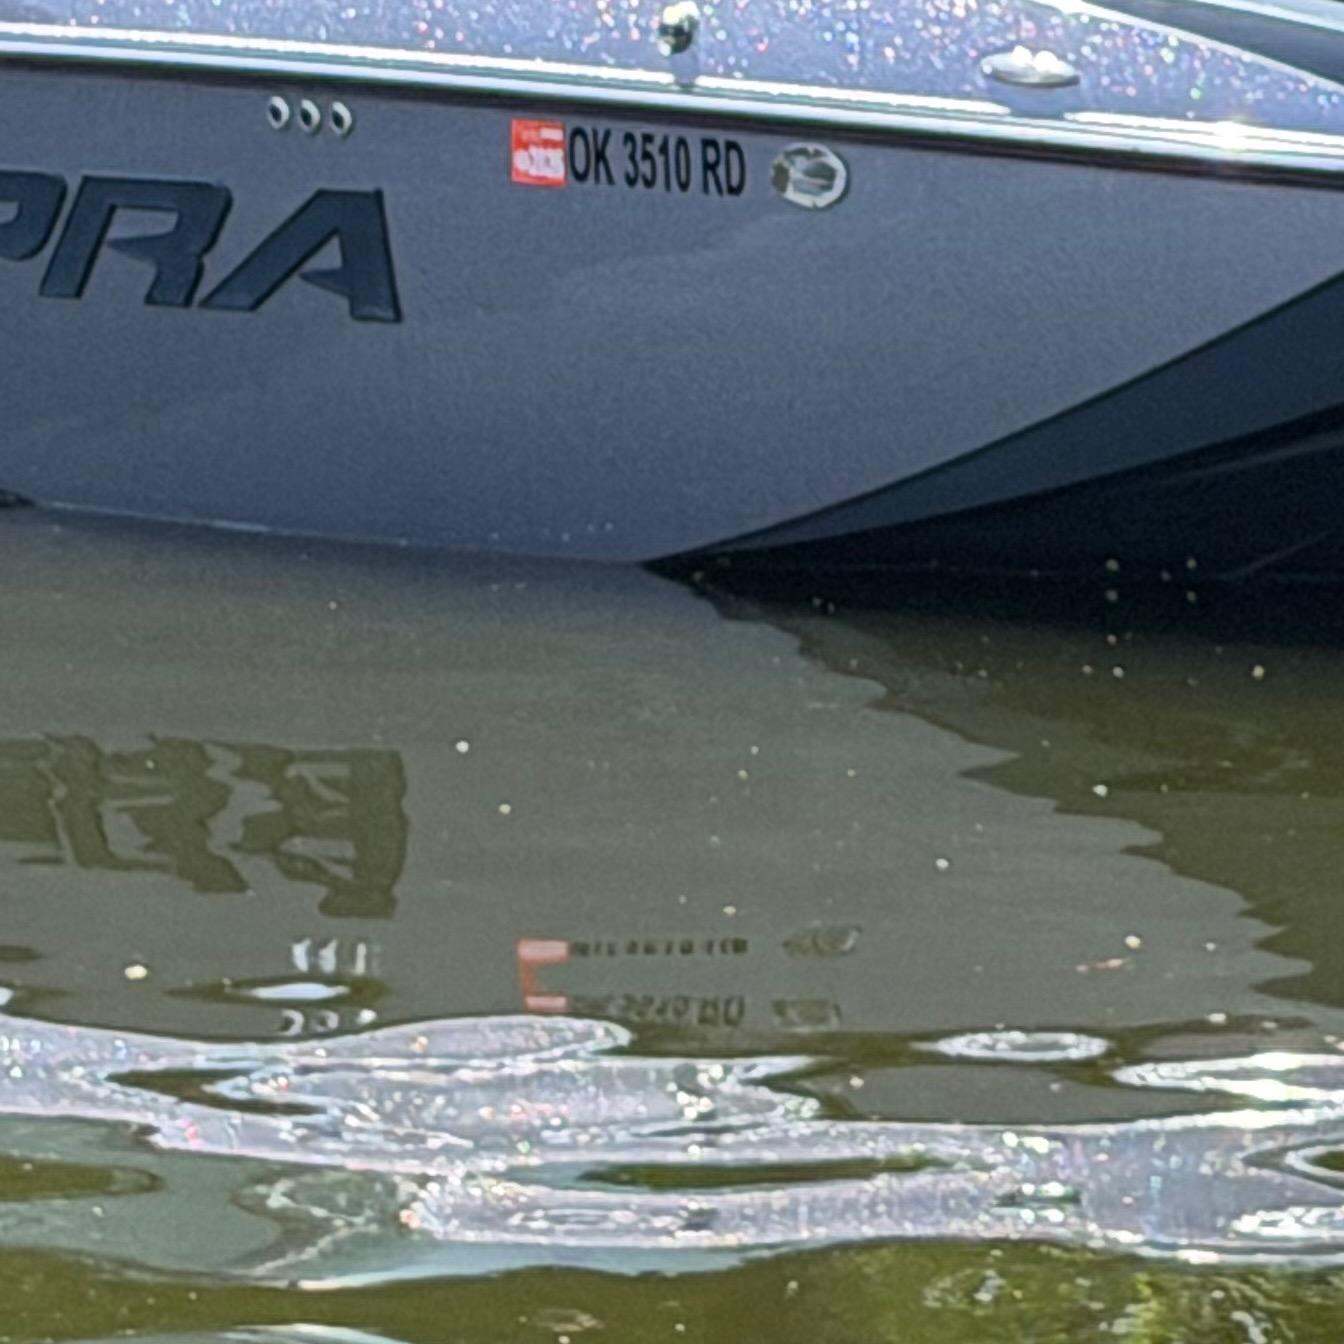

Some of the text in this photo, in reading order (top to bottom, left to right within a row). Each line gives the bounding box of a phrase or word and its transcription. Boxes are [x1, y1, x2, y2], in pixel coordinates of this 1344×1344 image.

[568, 126, 615, 186] OK
[623, 131, 690, 193] 3510
[700, 138, 746, 197] RD
